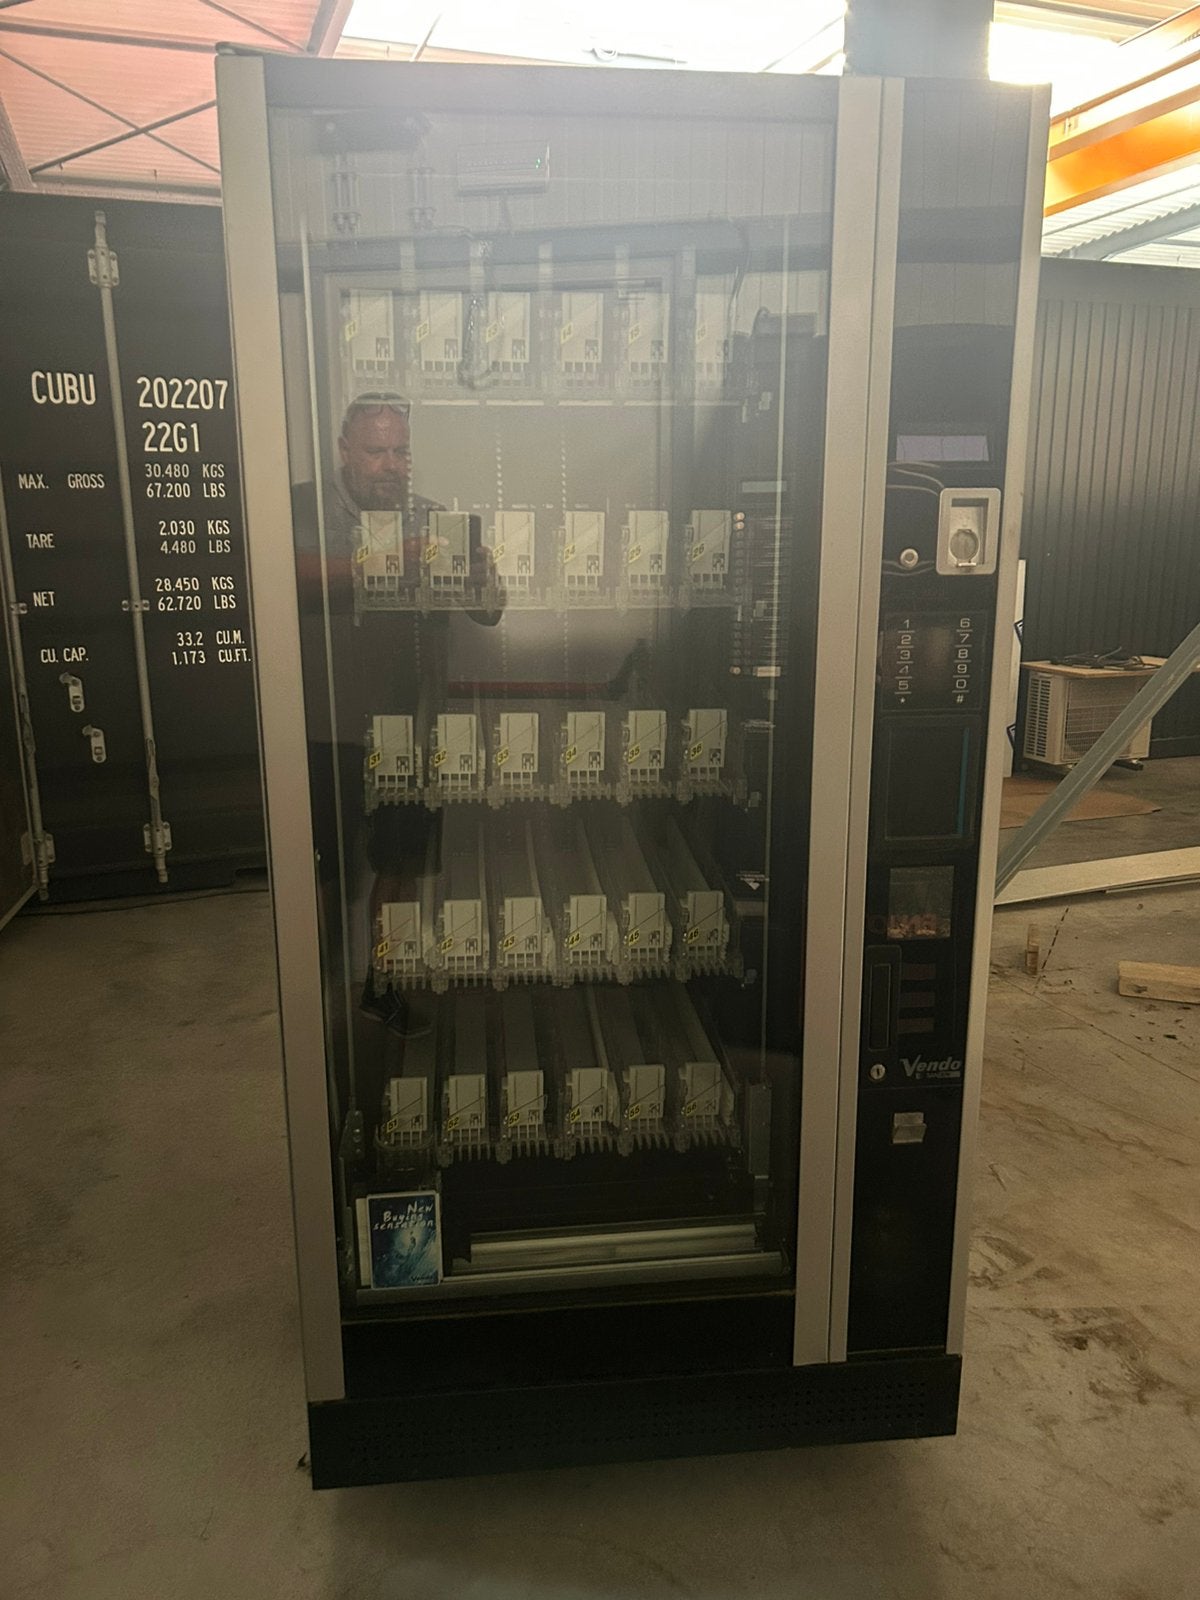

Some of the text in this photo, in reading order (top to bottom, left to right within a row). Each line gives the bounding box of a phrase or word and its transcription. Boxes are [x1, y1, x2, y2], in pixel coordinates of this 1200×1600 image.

[31, 371, 229, 410] CUBU 202207
[142, 421, 200, 453] 22G1
[145, 464, 225, 478] 30.480 KGS
[18, 473, 105, 489] MAX. GROSS
[146, 482, 226, 498] 67.200 LBS
[159, 520, 230, 536] 2.030 KGS
[26, 533, 55, 549] TARE
[160, 539, 231, 555] 4.480 LBS
[155, 576, 234, 593] 28.450 KGS
[33, 591, 55, 607] NET
[157, 595, 236, 611] 62.720 LBS
[904, 618, 910, 629] 1
[960, 618, 970, 628] 6
[177, 630, 245, 647] 33.2 CU.M.
[901, 634, 912, 645] 2
[960, 633, 970, 644] 7
[40, 647, 89, 664] CU. CAP.
[172, 648, 251, 665] 1.173 CU.FT.
[900, 650, 911, 660] 3
[958, 648, 969, 660] 8
[899, 664, 910, 676] 4
[957, 664, 968, 674] 9
[898, 680, 909, 690] 5
[899, 1054, 961, 1077] Vendo
[407, 1200, 434, 1214] New
